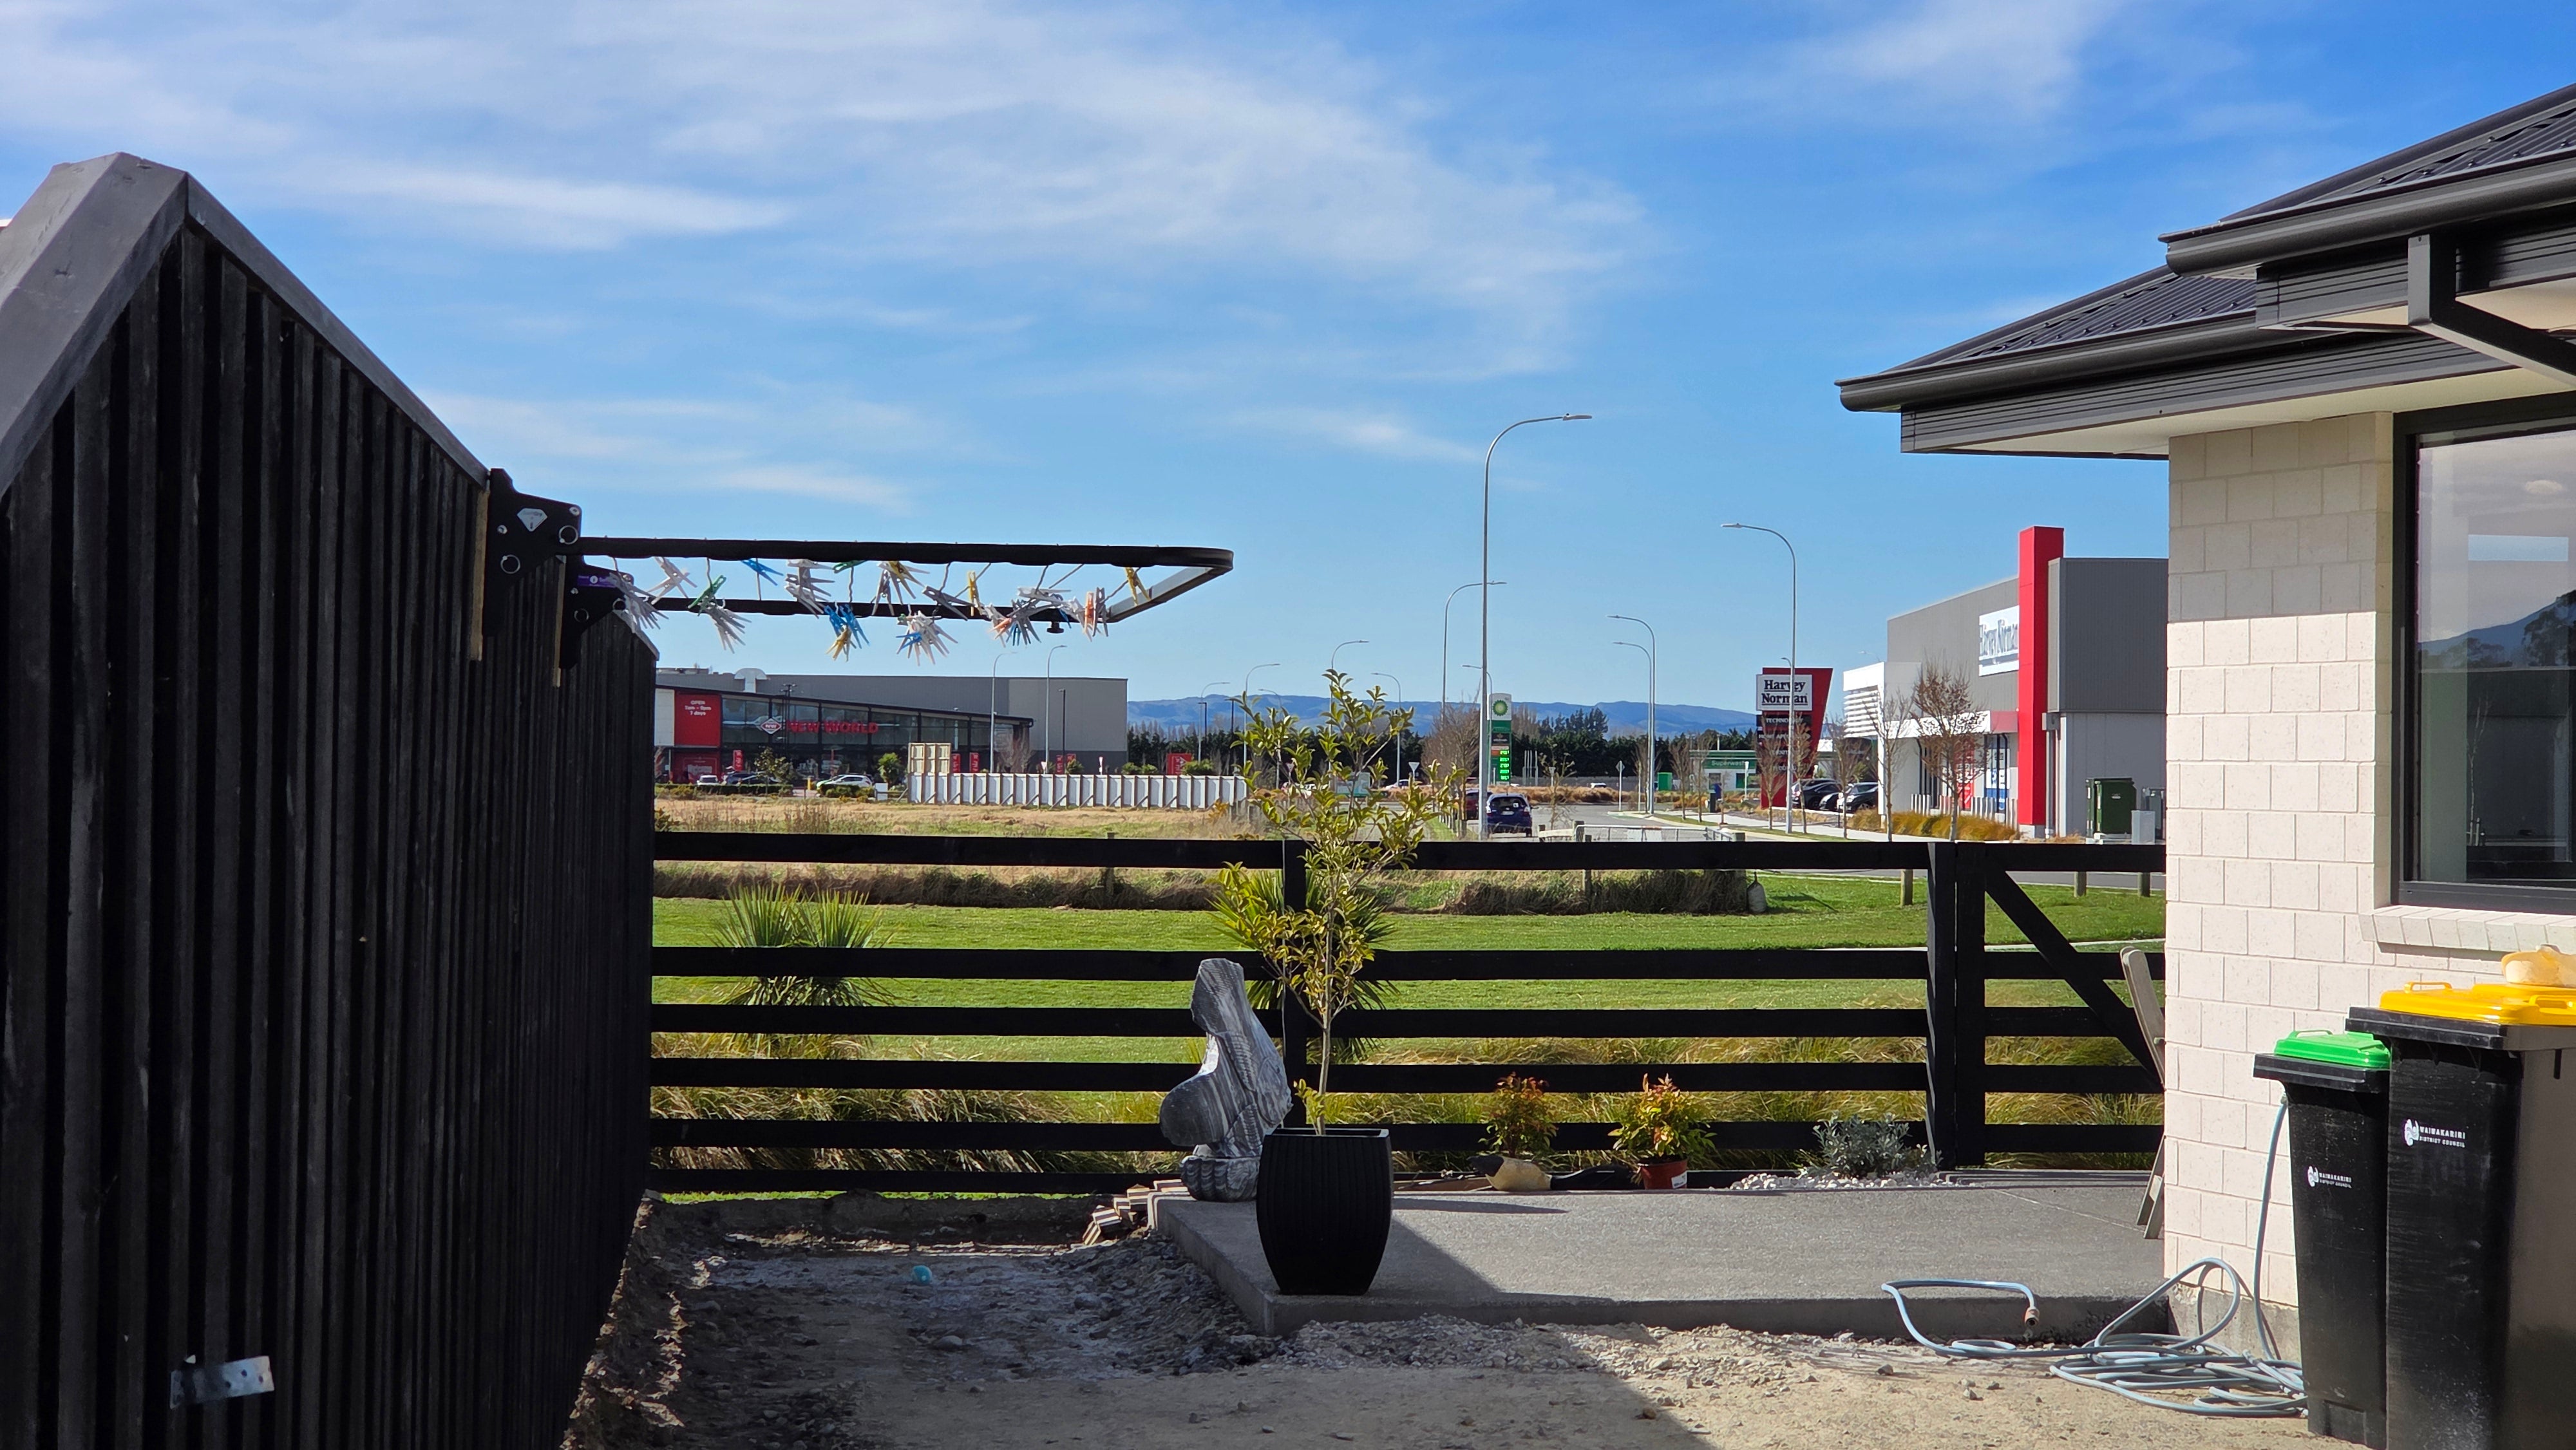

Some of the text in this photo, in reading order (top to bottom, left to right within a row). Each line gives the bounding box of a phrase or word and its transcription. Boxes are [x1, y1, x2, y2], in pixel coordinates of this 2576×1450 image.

[1764, 679, 1806, 692] Harvey
[1761, 693, 1808, 703] Norman
[824, 721, 879, 734] WORLD
[2420, 1126, 2465, 1139] WAIMAKARIRI
